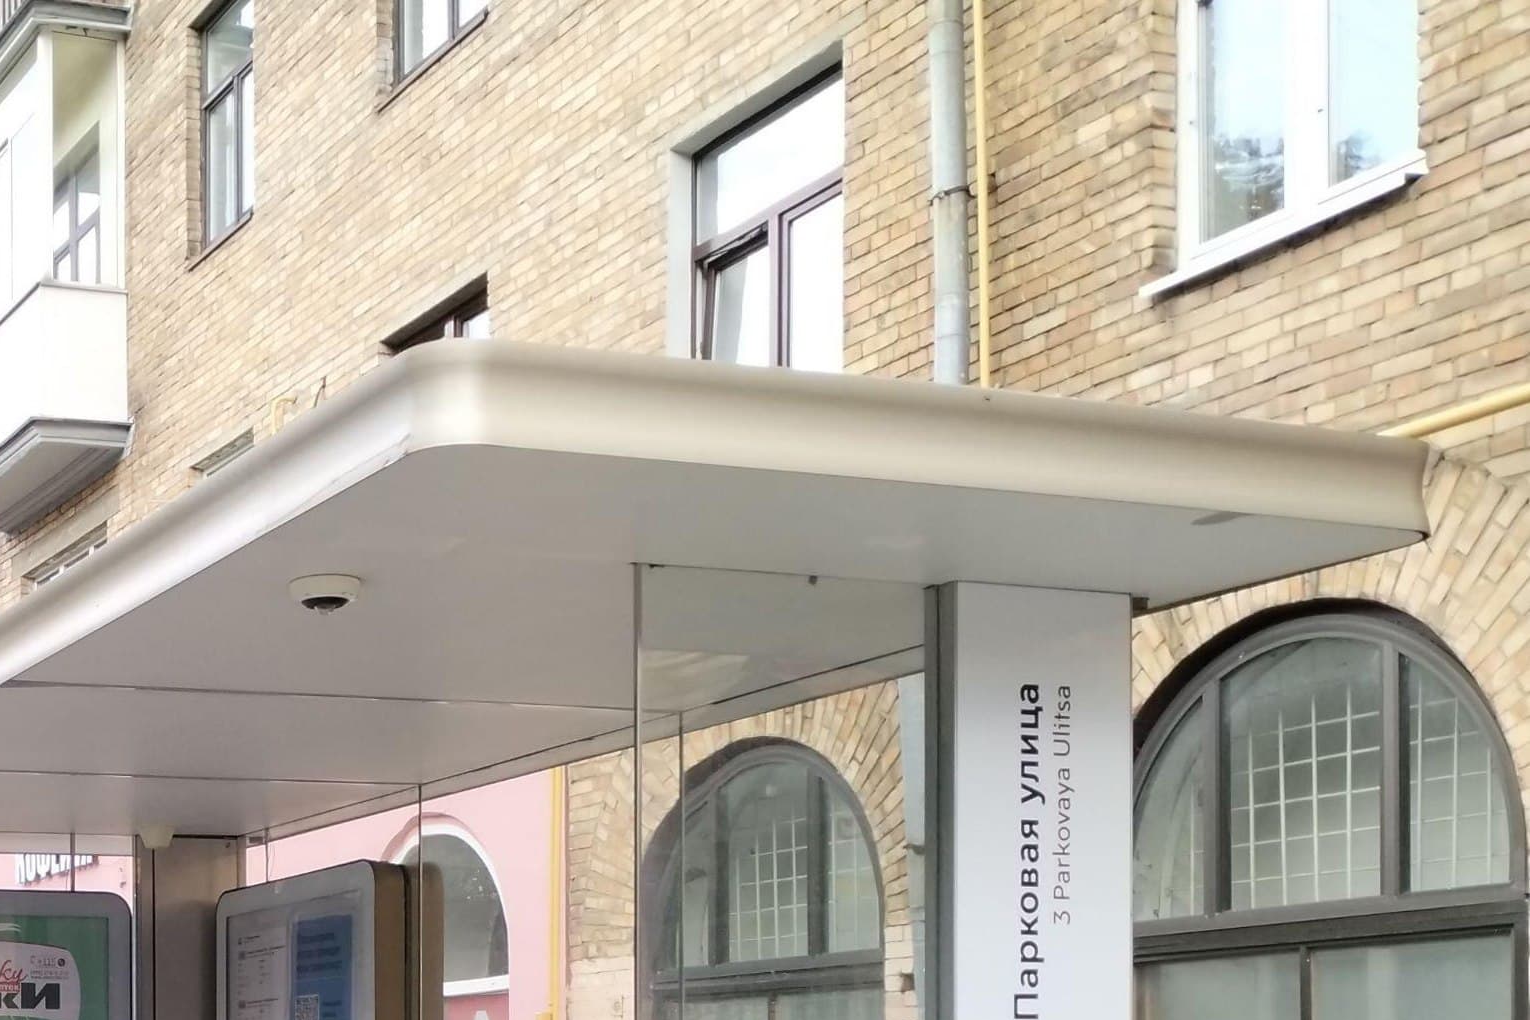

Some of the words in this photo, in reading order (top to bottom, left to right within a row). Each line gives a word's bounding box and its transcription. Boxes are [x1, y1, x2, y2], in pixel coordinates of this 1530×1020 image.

[1019, 682, 1046, 804] улица
[1052, 684, 1071, 757] Ulitsa
[1052, 767, 1075, 901] Parkovaya
[1013, 817, 1045, 1020] Парковая
[1052, 909, 1071, 926] 3
